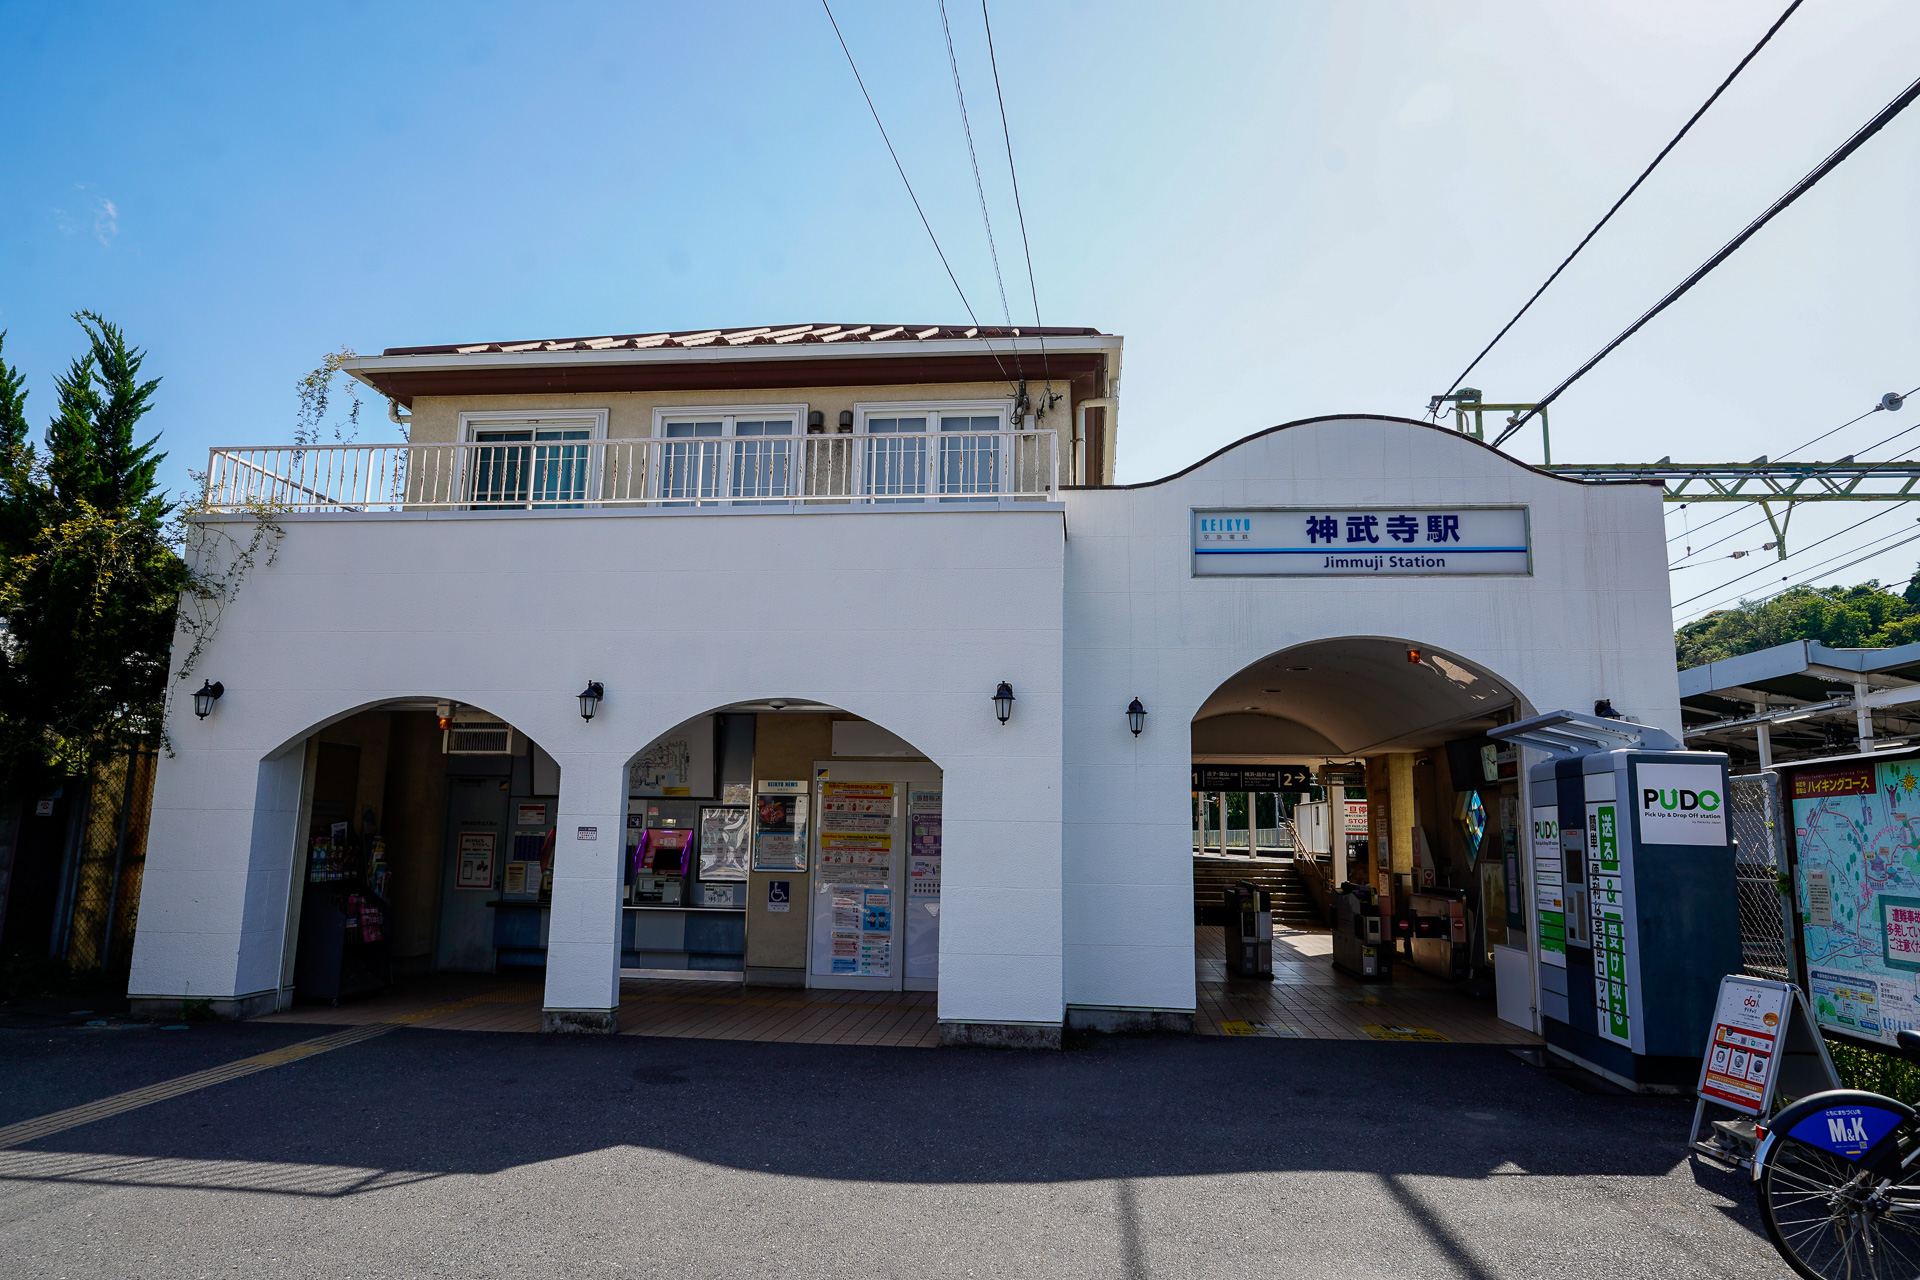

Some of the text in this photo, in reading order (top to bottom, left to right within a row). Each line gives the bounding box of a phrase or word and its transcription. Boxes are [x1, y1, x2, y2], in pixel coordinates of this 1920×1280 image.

[1201, 518, 1250, 531] KEIKYU
[1305, 514, 1461, 544] 神武寺駅
[1323, 556, 1446, 571] Jimmuji Station
[1283, 773, 1293, 786] 2
[1808, 776, 1870, 793] ハイキングコース
[1643, 788, 1721, 811] PUDO
[1534, 821, 1559, 839] PUDO
[1601, 814, 1613, 863] 送る
[1606, 878, 1616, 904] &
[1607, 924, 1624, 1026] 受け取る
[1826, 1116, 1869, 1142] M&K
